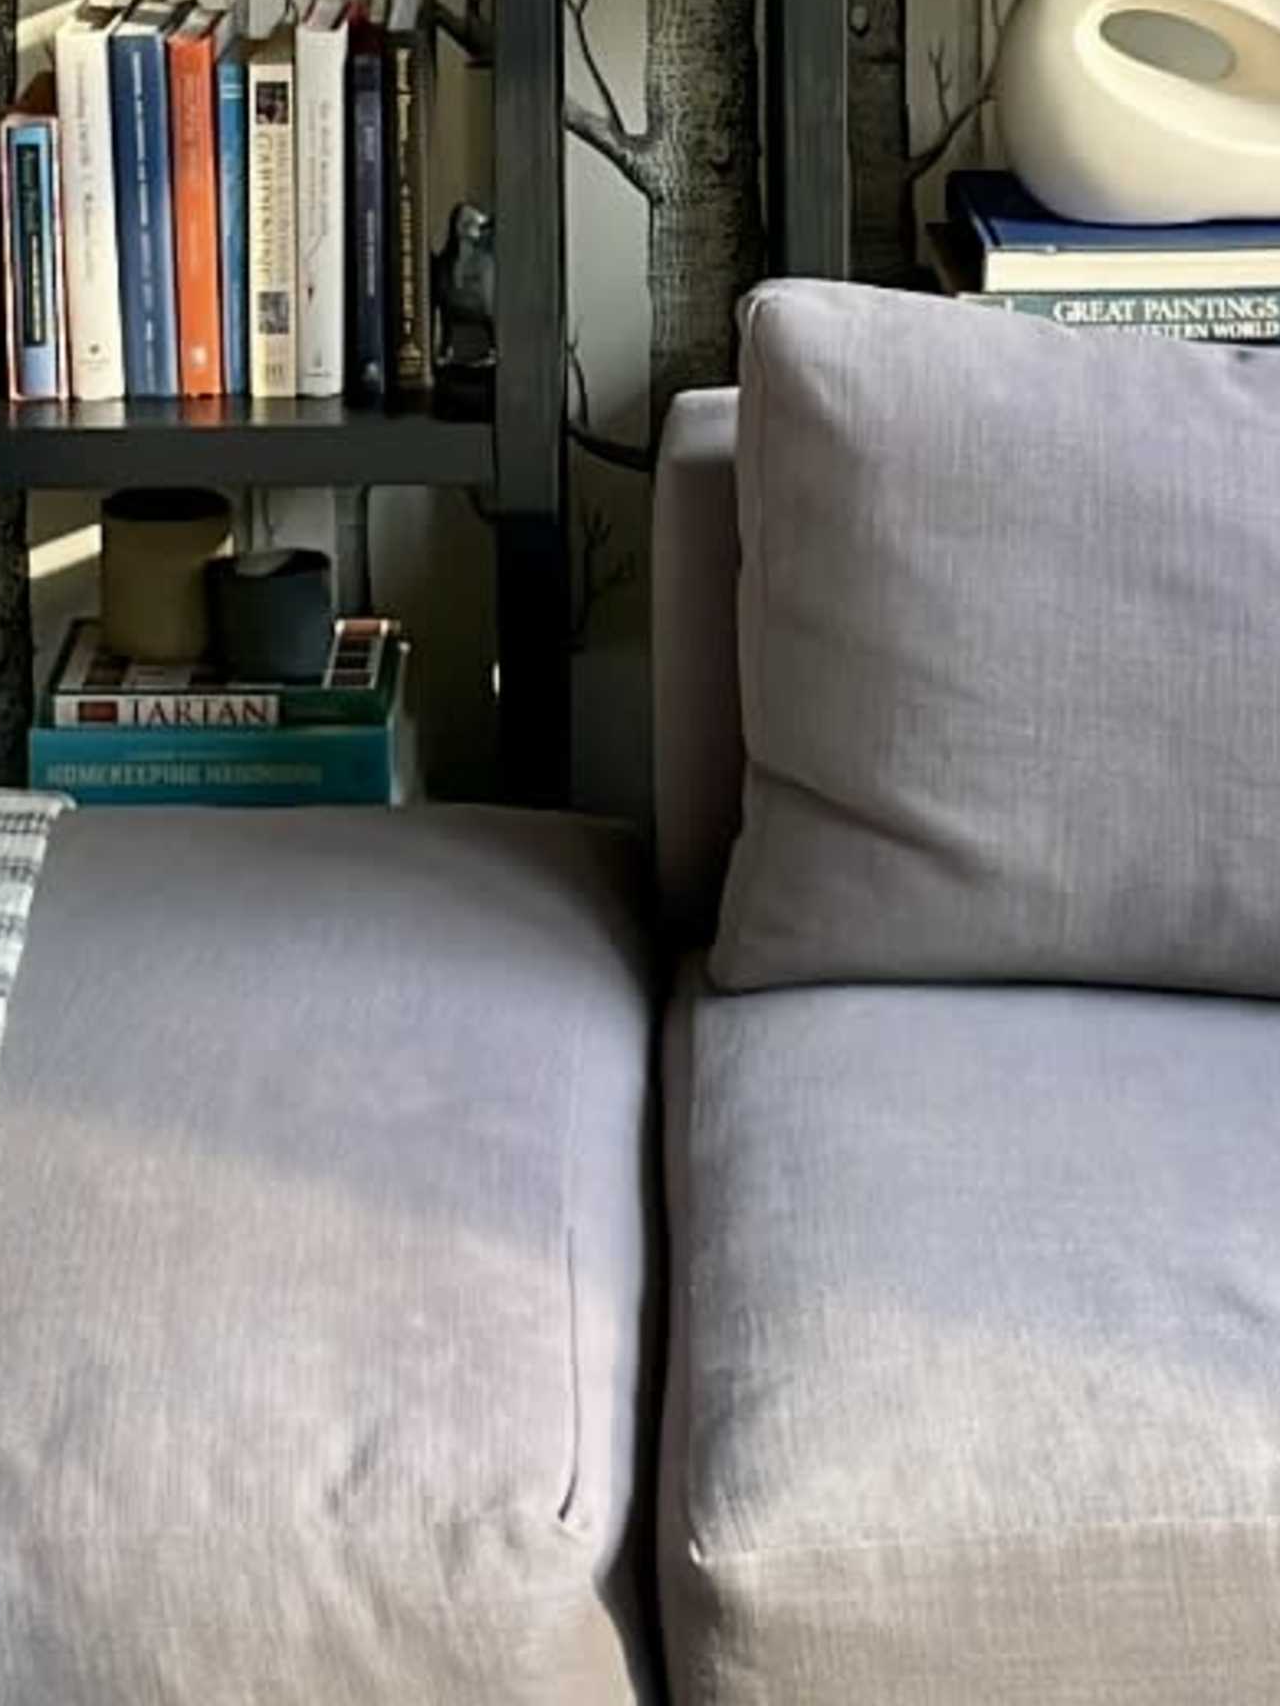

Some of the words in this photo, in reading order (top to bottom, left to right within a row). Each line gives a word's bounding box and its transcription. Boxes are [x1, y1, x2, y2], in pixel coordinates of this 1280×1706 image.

[1053, 300, 1136, 324] GREAT
[1143, 297, 1280, 323] PAINTINGS
[1212, 321, 1280, 340] WORLD
[130, 698, 268, 723] TARTAN
